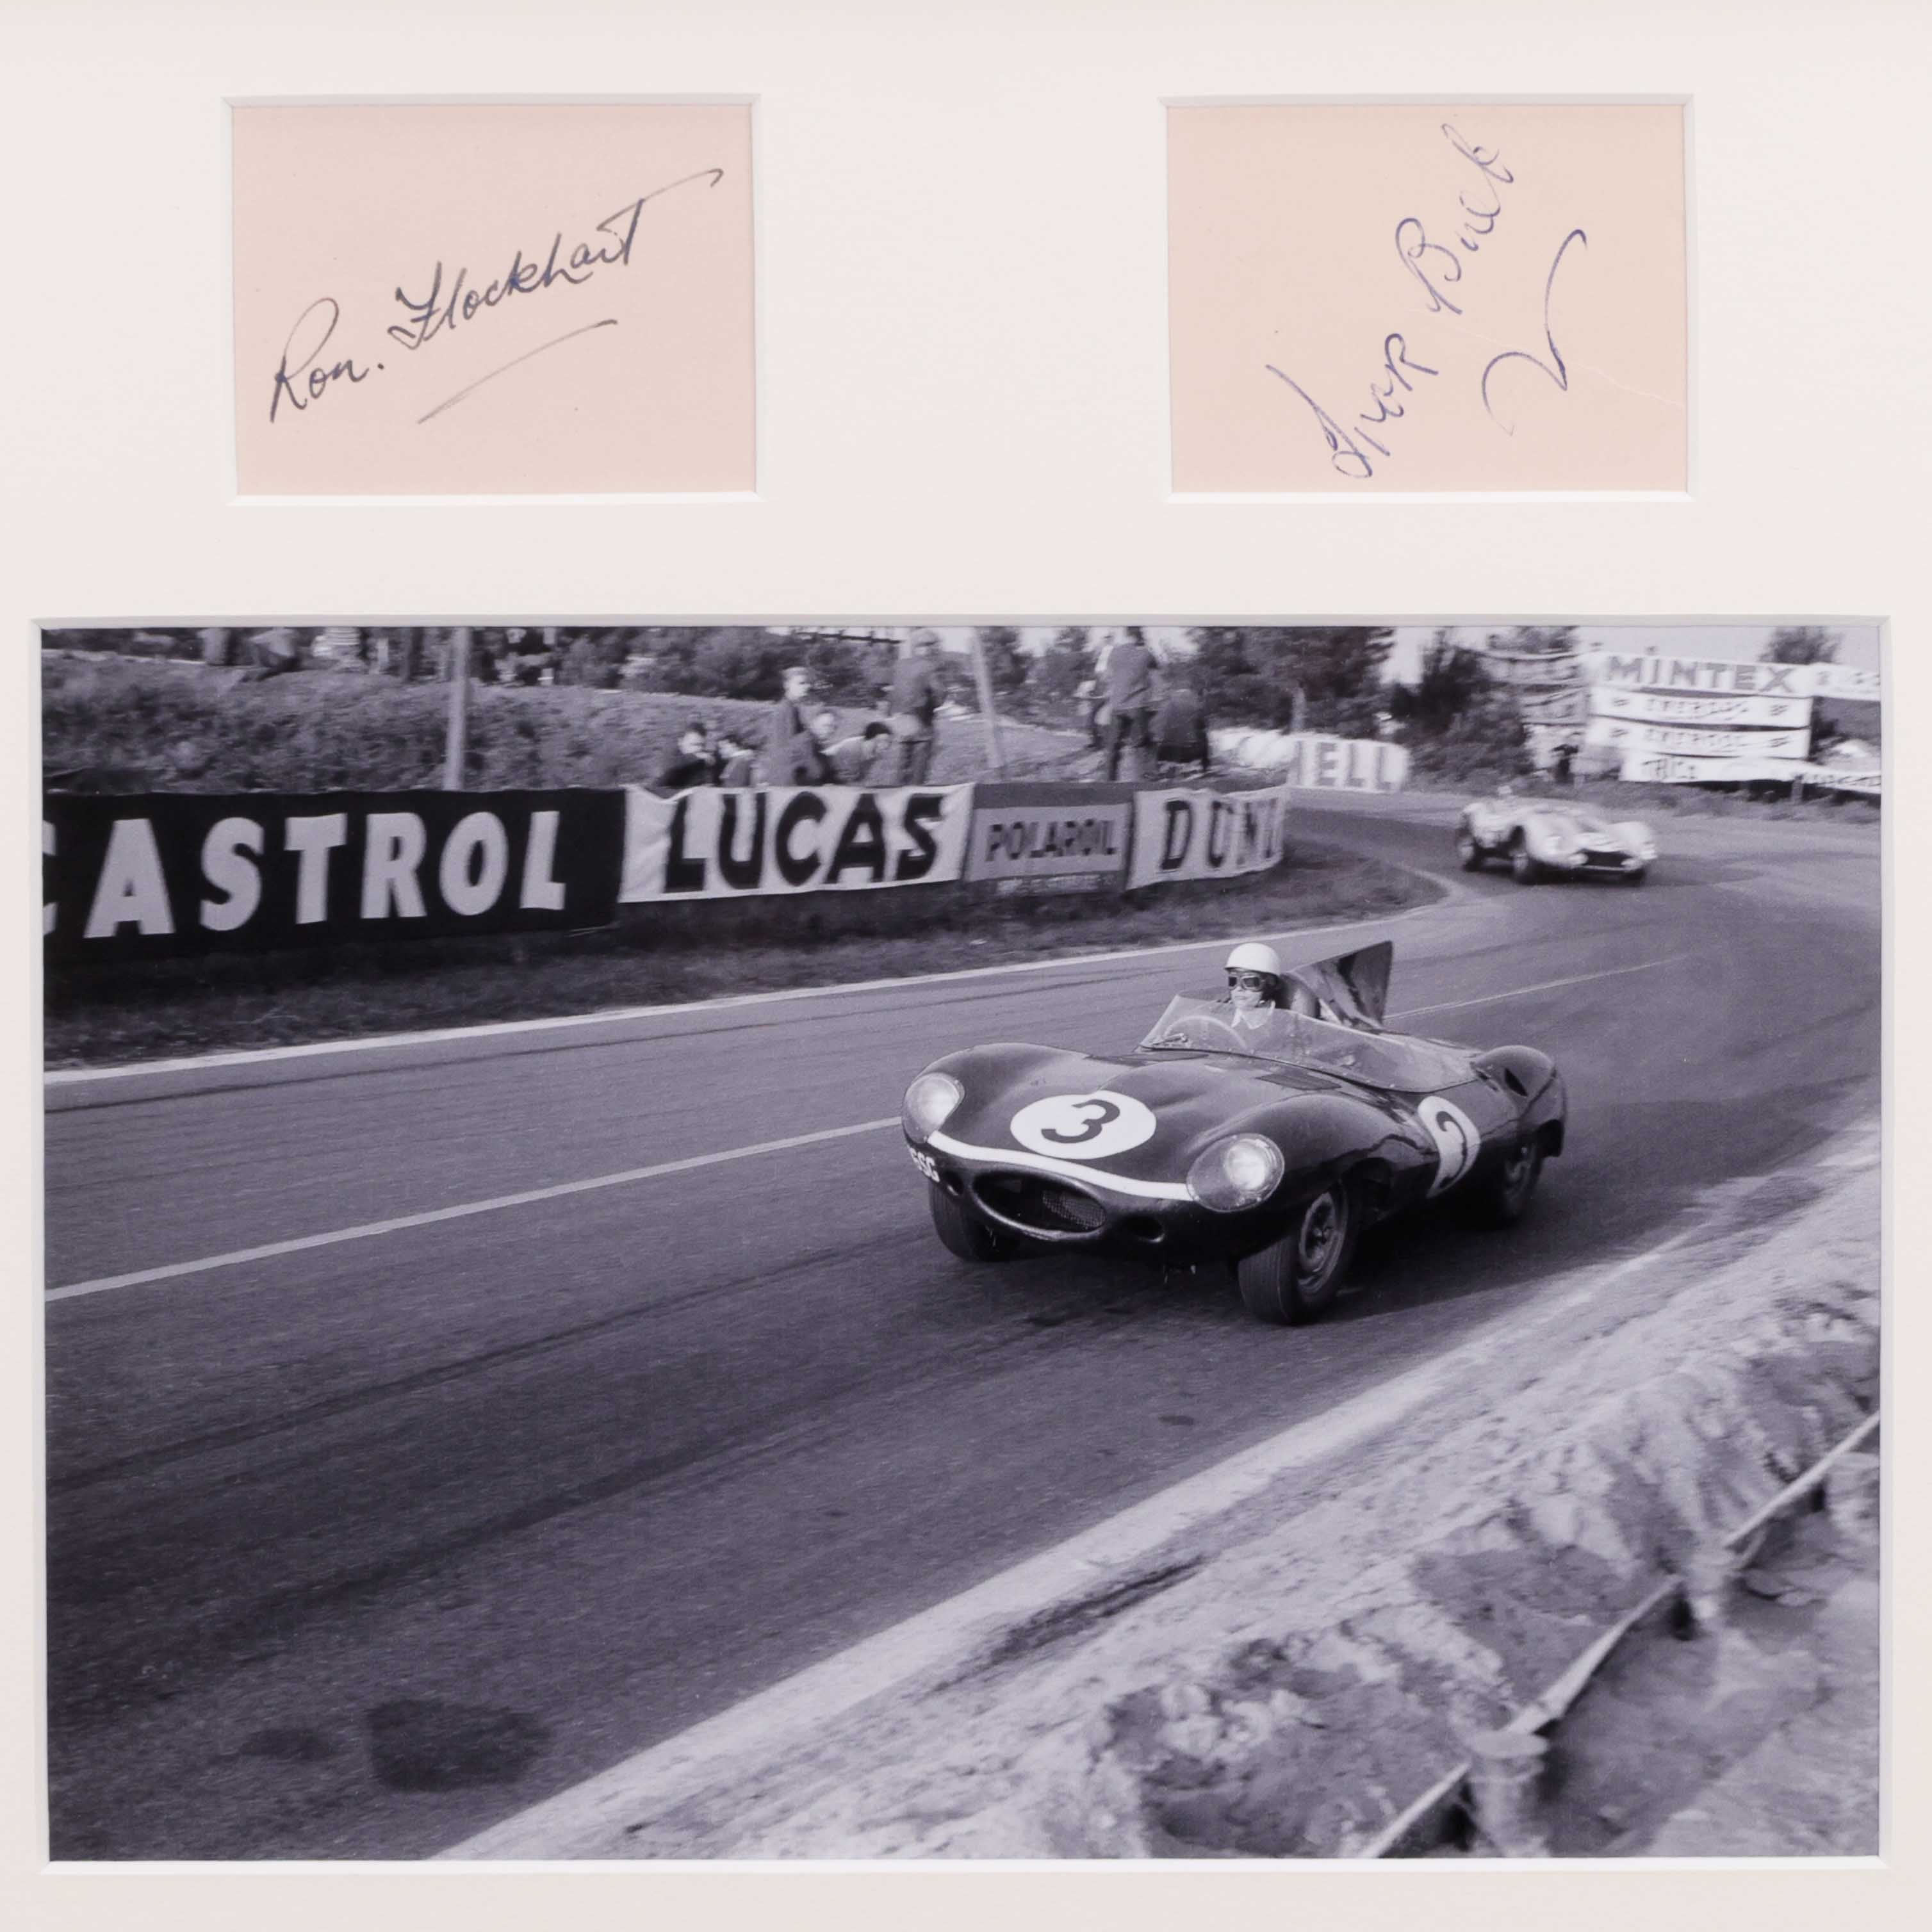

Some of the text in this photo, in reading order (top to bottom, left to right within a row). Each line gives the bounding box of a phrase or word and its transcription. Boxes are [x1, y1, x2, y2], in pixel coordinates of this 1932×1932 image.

[1605, 655, 1796, 693] MINTEX
[43, 810, 566, 939] ASTROL
[662, 790, 945, 894] LUCAS
[1041, 1099, 1120, 1144] 3
